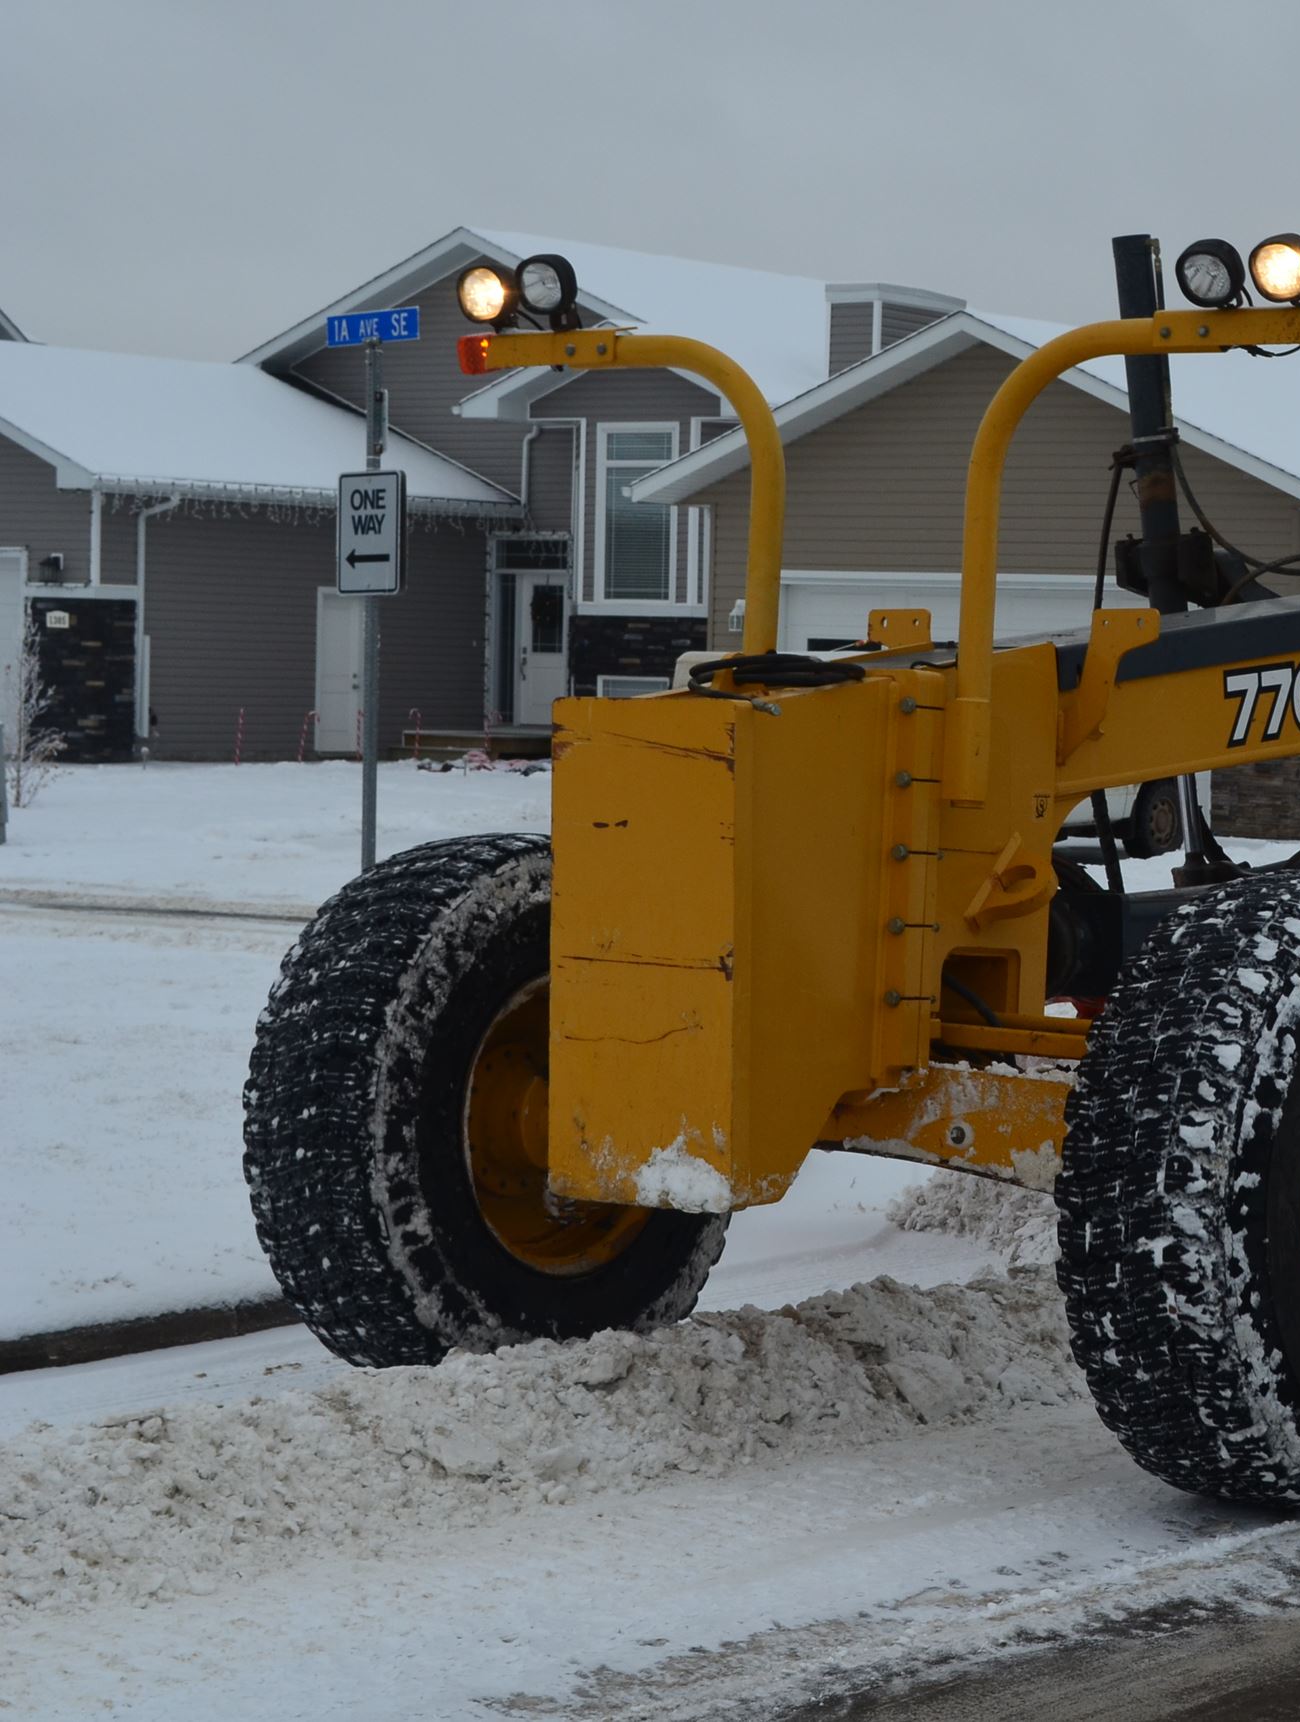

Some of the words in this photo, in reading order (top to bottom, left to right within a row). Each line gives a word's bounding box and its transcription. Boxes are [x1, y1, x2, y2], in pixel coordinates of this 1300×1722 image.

[334, 319, 349, 342] 1A
[359, 318, 379, 337] AVE
[391, 313, 408, 336] SE
[350, 489, 386, 511] ONE
[351, 514, 385, 536] WAY
